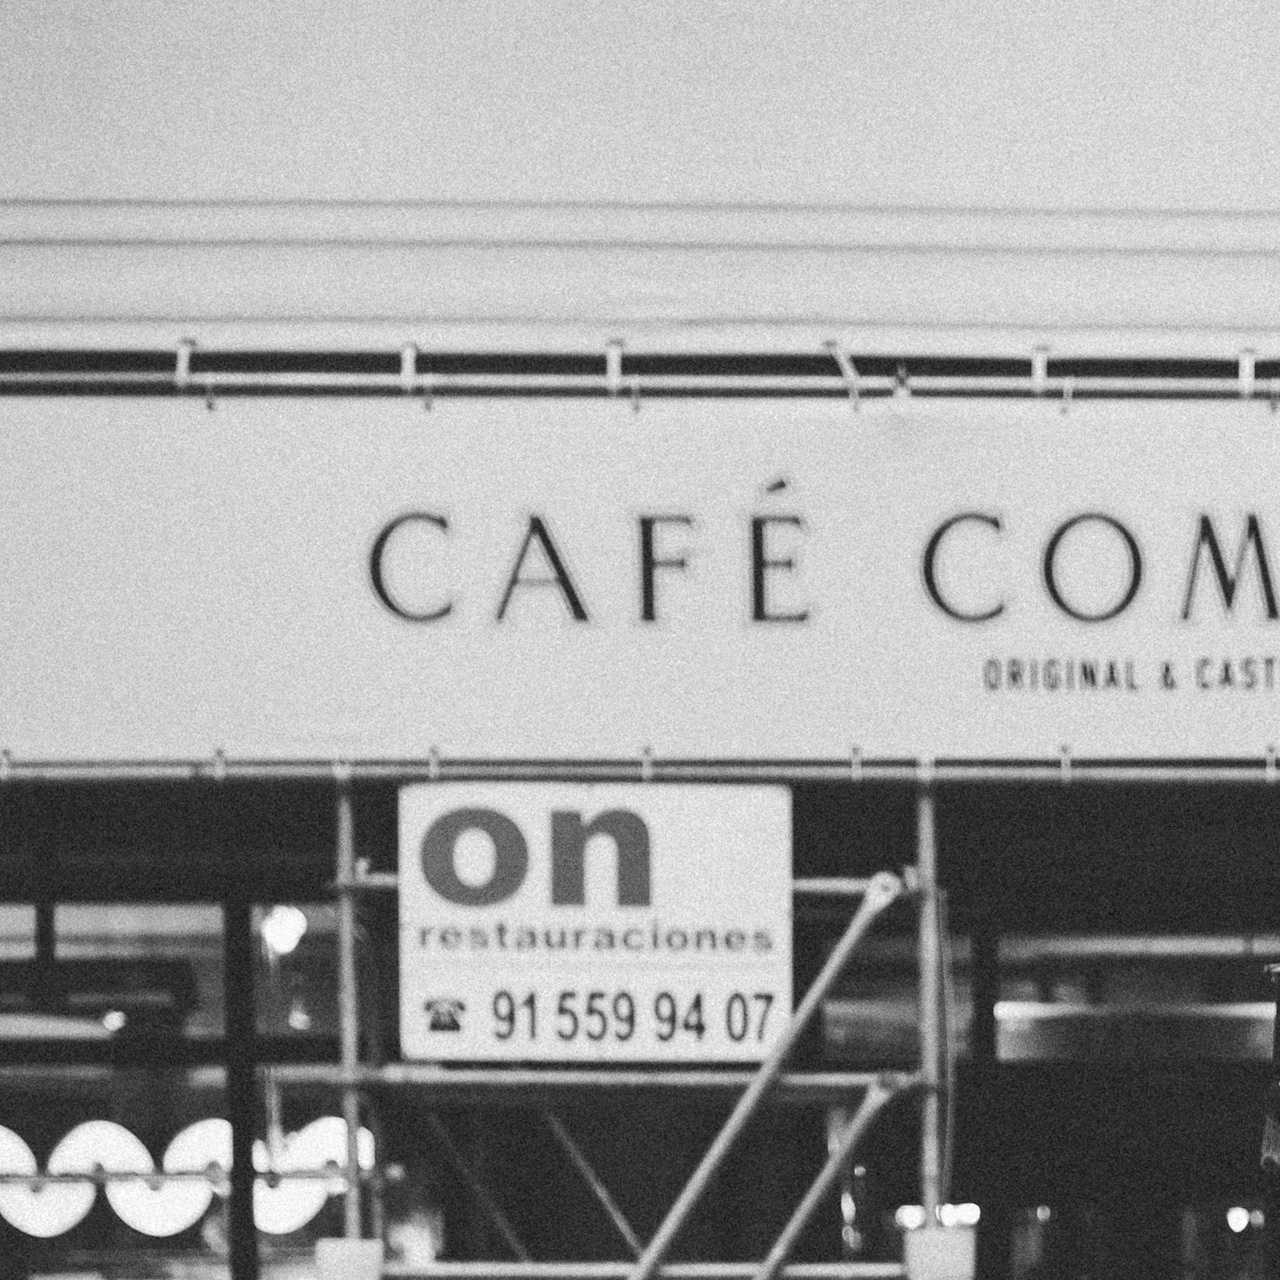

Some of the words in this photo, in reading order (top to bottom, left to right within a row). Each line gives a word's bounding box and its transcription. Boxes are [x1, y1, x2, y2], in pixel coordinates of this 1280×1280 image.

[368, 478, 810, 624] CAFÉ
[983, 657, 1138, 692] ORIGINAL
[1159, 660, 1178, 692] &
[421, 808, 651, 907] on
[418, 919, 774, 953] restauraciones
[493, 990, 536, 1041] 91
[557, 991, 636, 1042] 559
[655, 992, 706, 1042] 94
[726, 992, 774, 1042] 07
